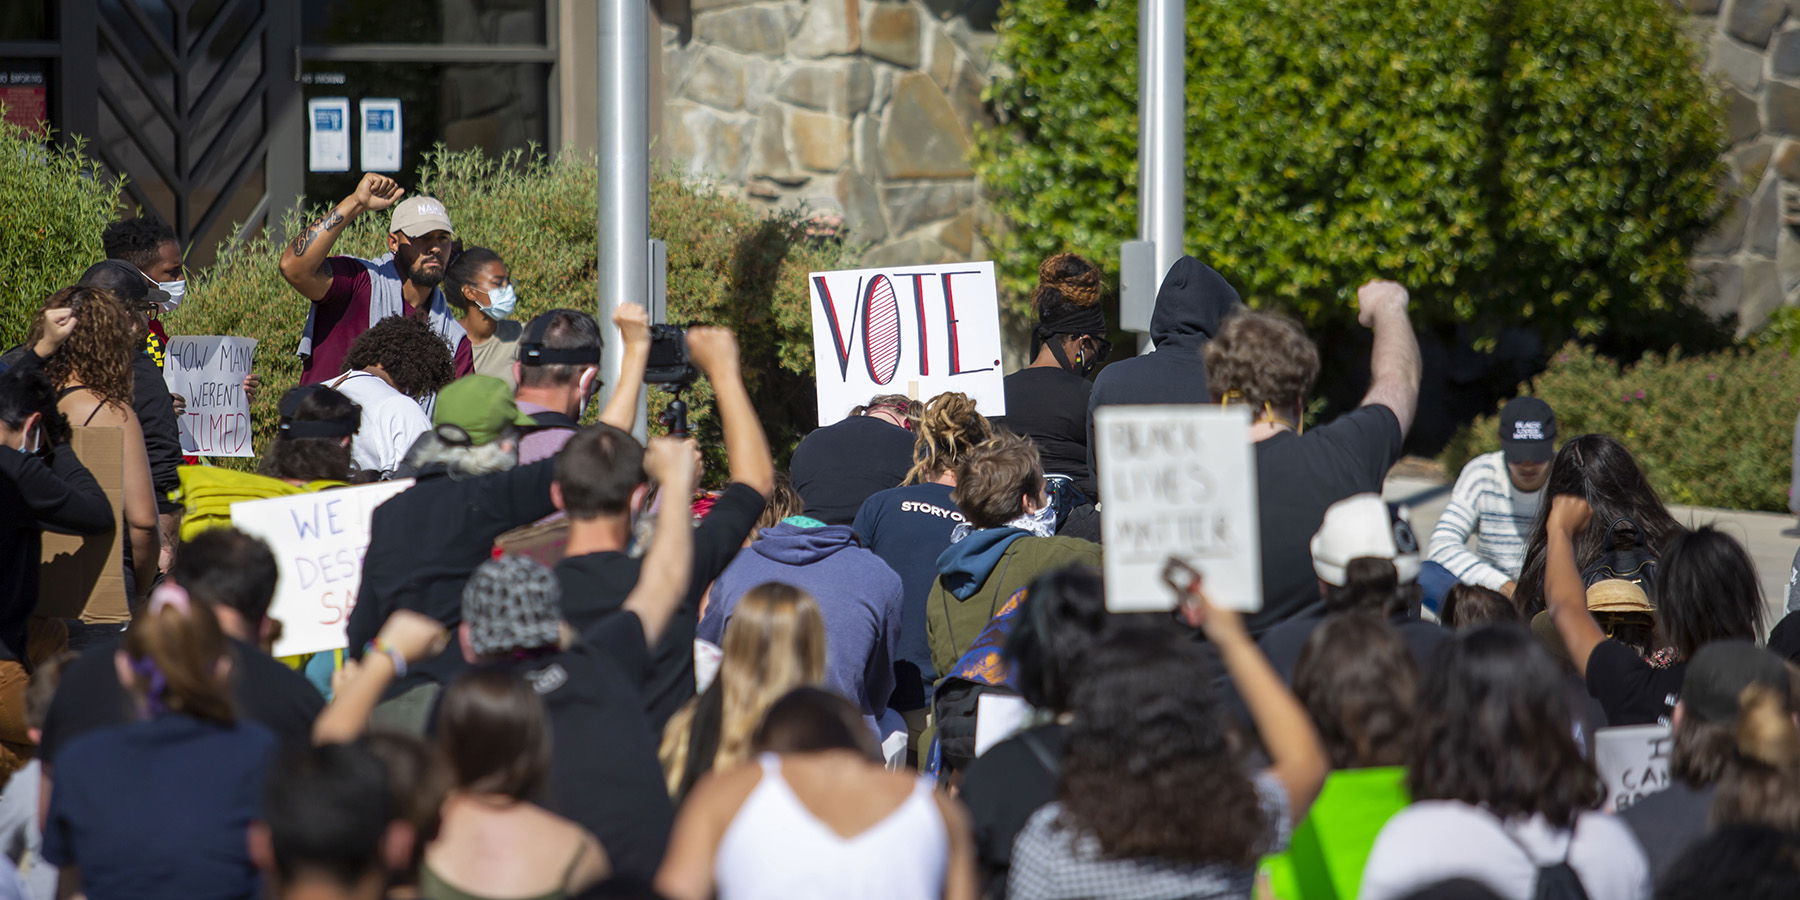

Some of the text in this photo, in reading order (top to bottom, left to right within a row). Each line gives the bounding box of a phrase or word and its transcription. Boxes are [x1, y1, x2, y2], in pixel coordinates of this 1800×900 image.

[812, 270, 1001, 386] VOTE.
[169, 340, 256, 375] HOW MANY
[189, 382, 240, 408] WEREN'T
[178, 412, 248, 454] ILMED
[290, 499, 344, 539] WE
[901, 501, 966, 522] STORYO
